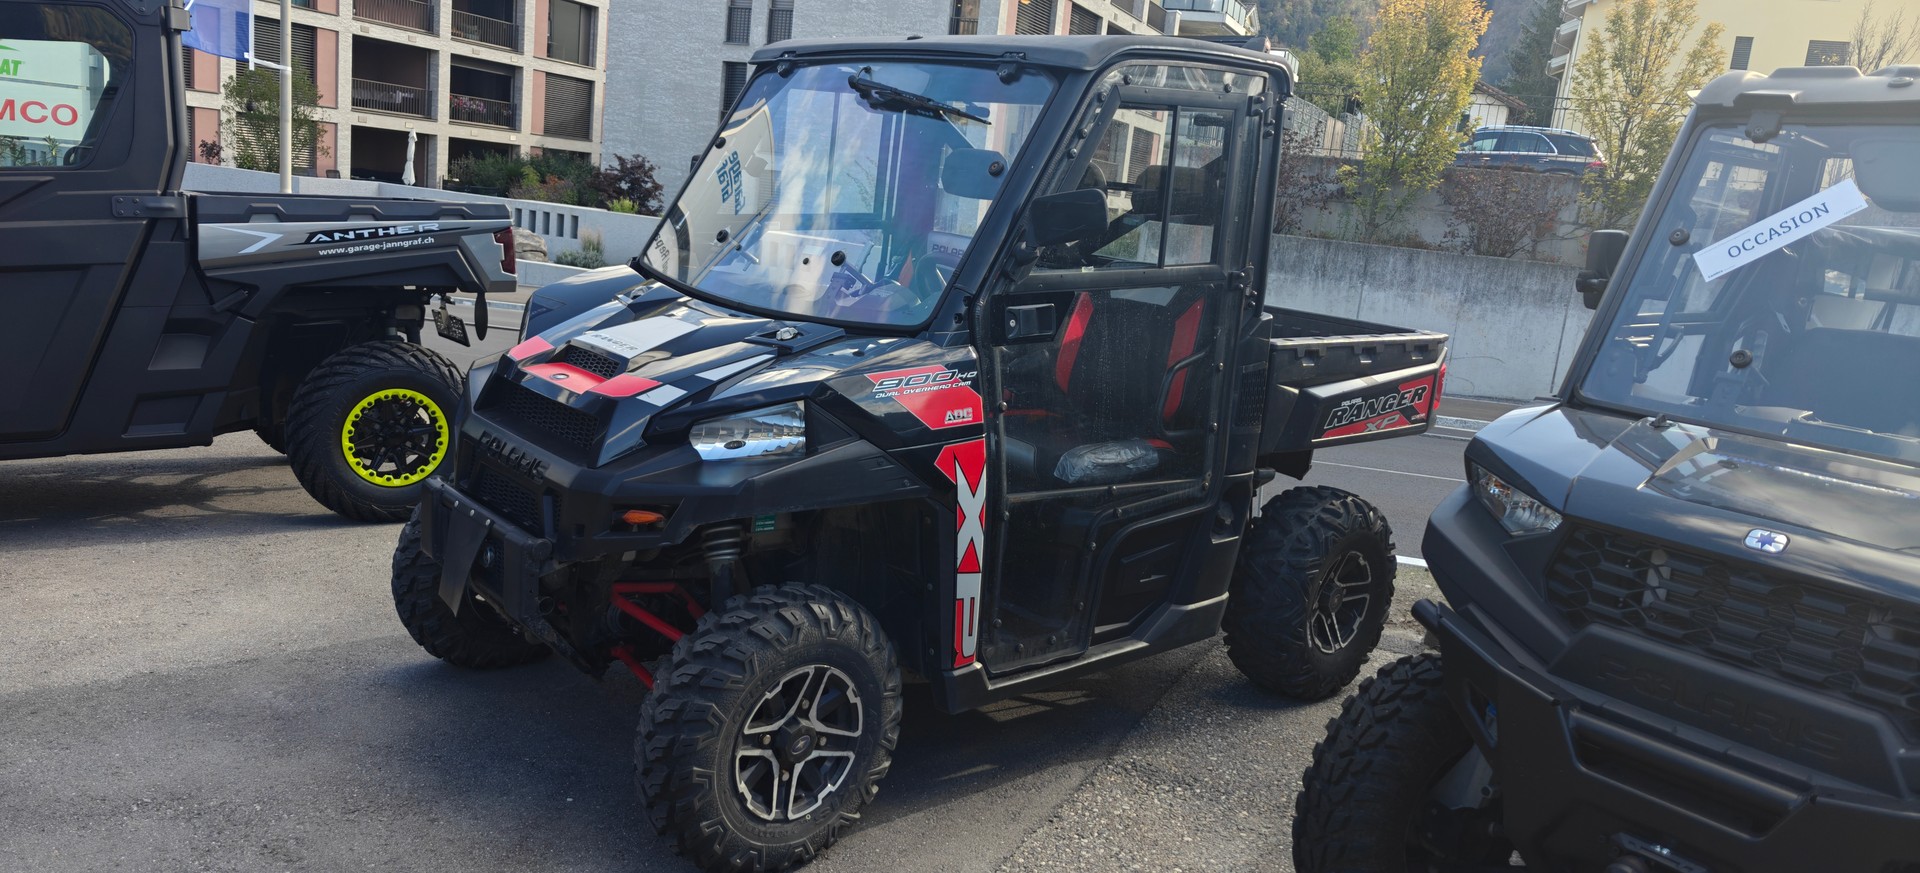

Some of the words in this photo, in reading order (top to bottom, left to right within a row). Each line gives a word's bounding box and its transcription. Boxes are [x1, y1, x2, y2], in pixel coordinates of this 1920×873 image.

[310, 223, 439, 243] ANTHER
[1727, 201, 1830, 258] OCCASION
[319, 236, 434, 255] www.garage-janngraf.ch
[872, 369, 958, 392] 900
[875, 390, 901, 399] DUAL
[903, 383, 951, 395] OVERHEAD
[1324, 385, 1428, 429] RANGER
[1363, 413, 1401, 433] XP
[954, 452, 986, 659] XP
[1596, 654, 1843, 761] POLARIS
